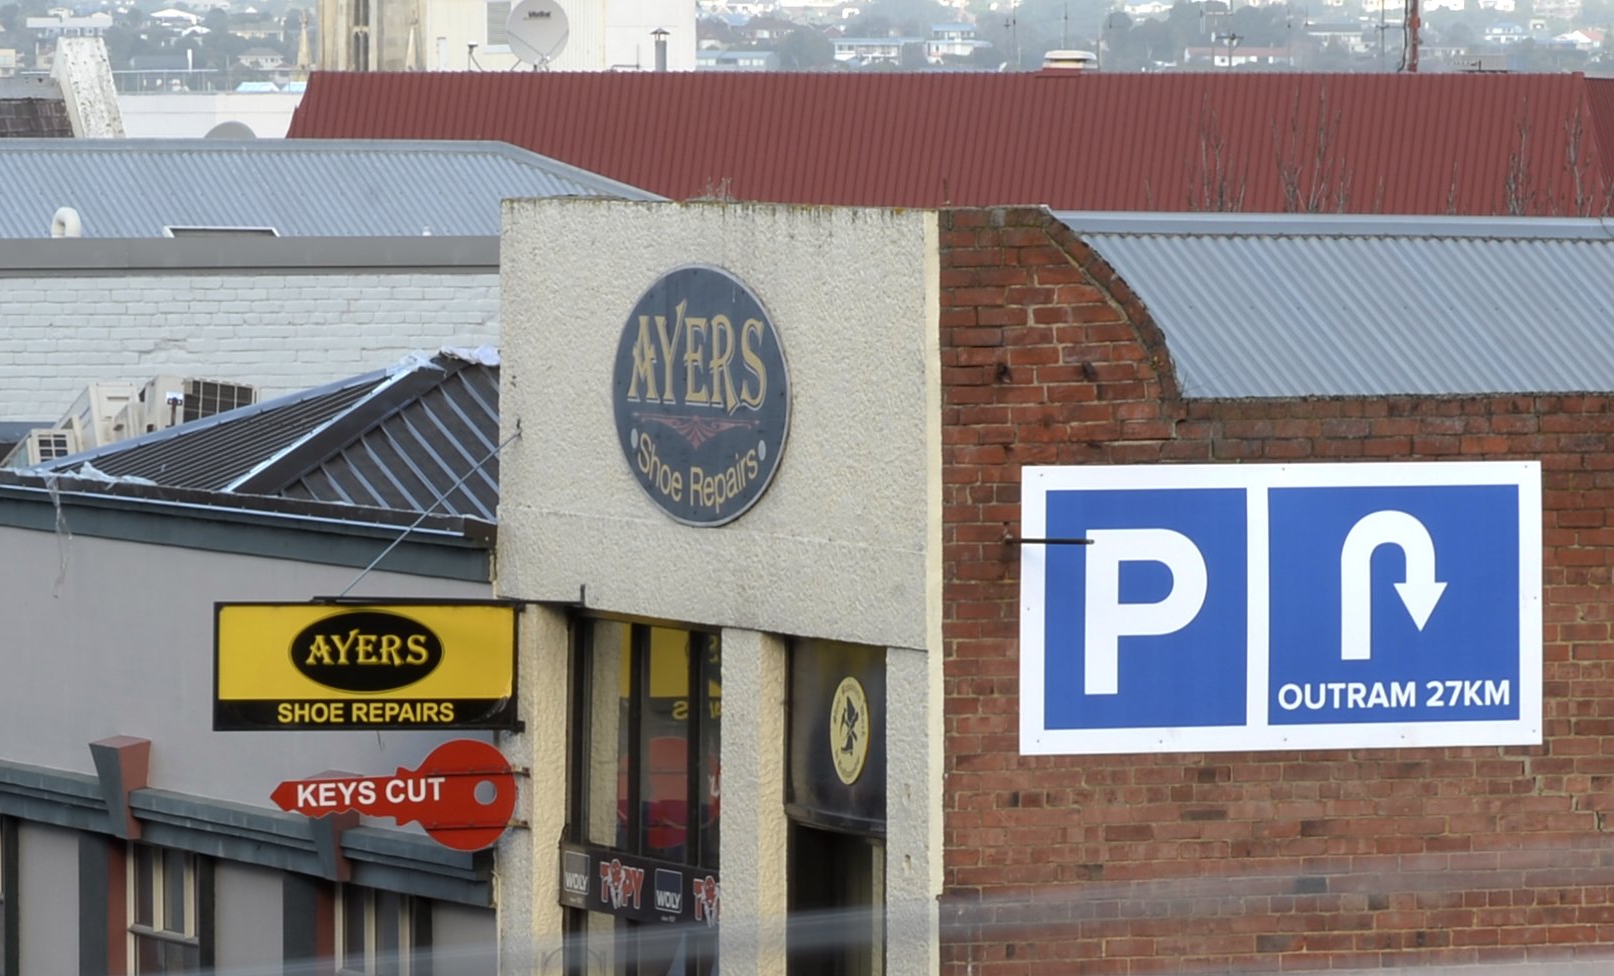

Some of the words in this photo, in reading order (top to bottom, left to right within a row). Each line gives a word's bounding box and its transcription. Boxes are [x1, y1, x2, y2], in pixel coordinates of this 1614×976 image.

[627, 299, 768, 416] AYERS
[637, 432, 683, 502] Shoe
[690, 449, 759, 514] Repairs
[1084, 527, 1208, 695] P
[306, 628, 429, 668] AYERS
[1277, 681, 1416, 710] OUTRAM
[1425, 679, 1510, 708] 27KM
[277, 702, 344, 724] SHOE
[352, 702, 455, 723] REPAIRS
[297, 780, 377, 808] KEYS
[385, 777, 446, 804] CUT
[565, 871, 588, 890] WOLY
[656, 890, 682, 910] WOLY
